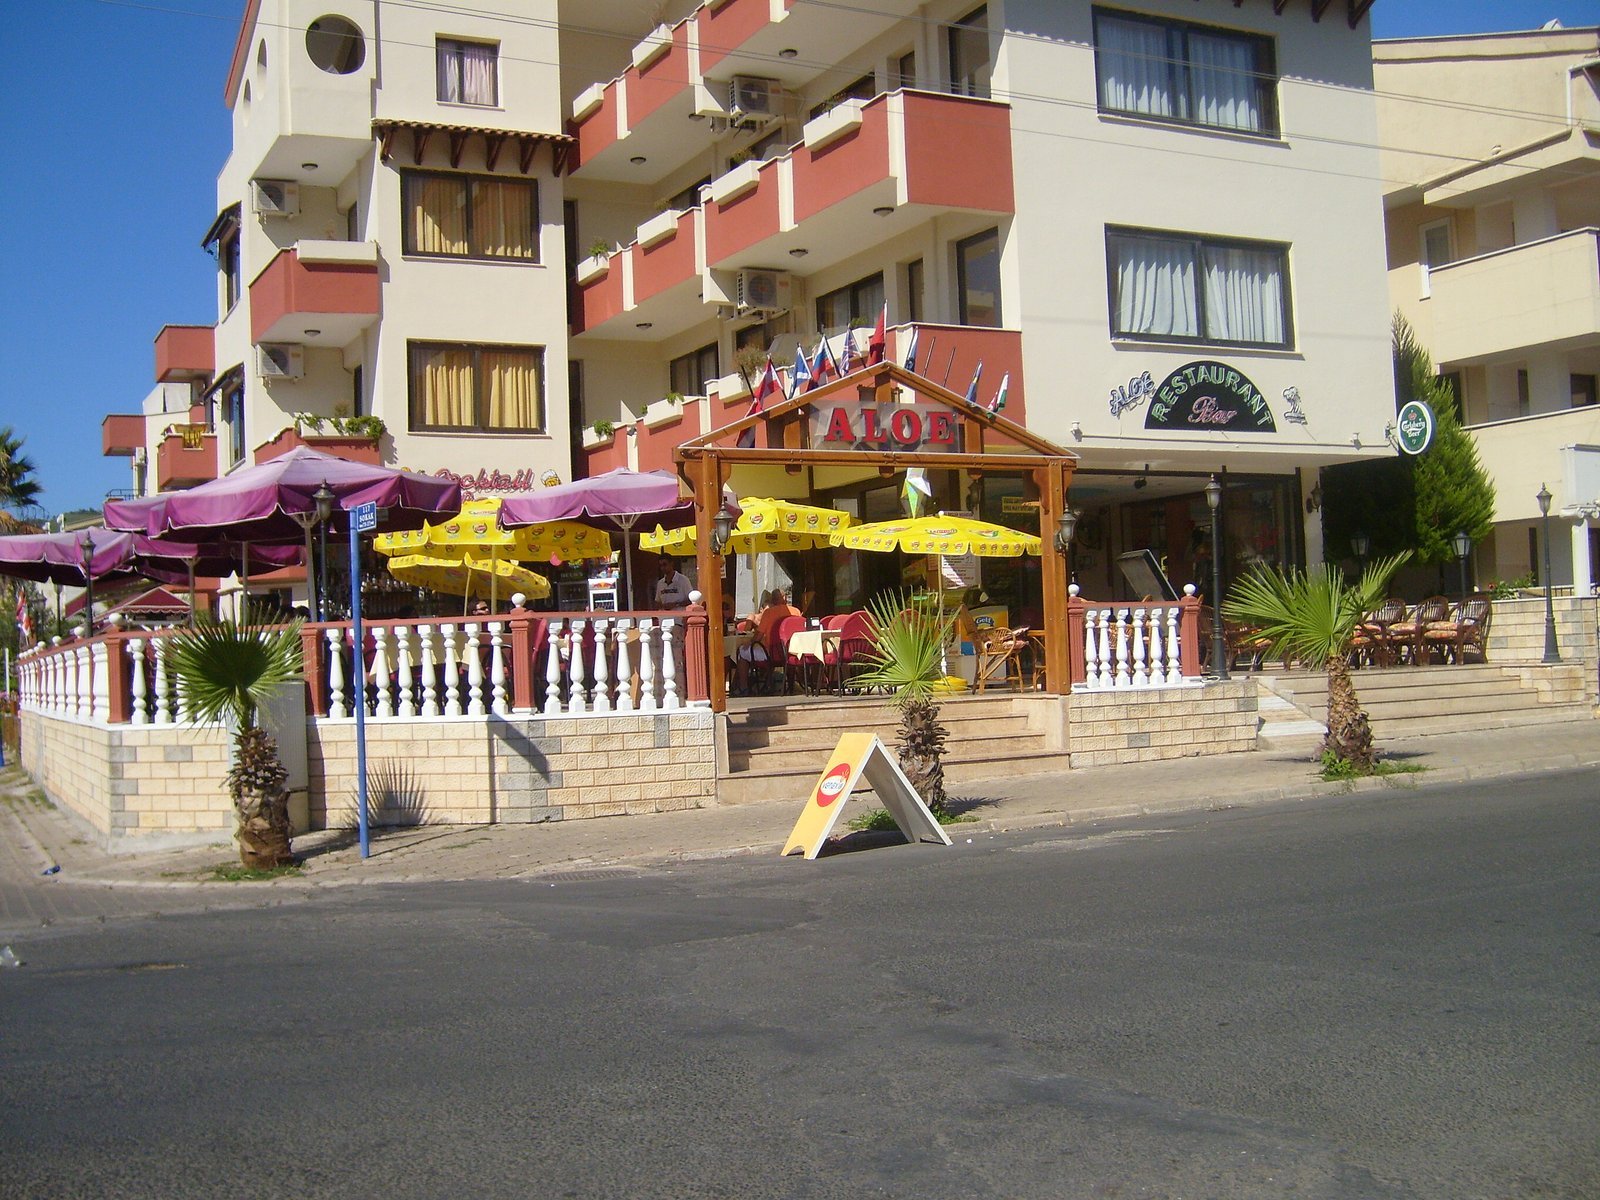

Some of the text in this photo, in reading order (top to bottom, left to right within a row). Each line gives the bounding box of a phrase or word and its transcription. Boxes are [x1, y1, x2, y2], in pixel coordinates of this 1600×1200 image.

[1109, 371, 1156, 418] ALOE
[1151, 365, 1273, 426] RESTAURANT
[1187, 396, 1237, 425] Bar
[824, 407, 954, 445] ALOE
[1401, 418, 1426, 432] Carlsberg
